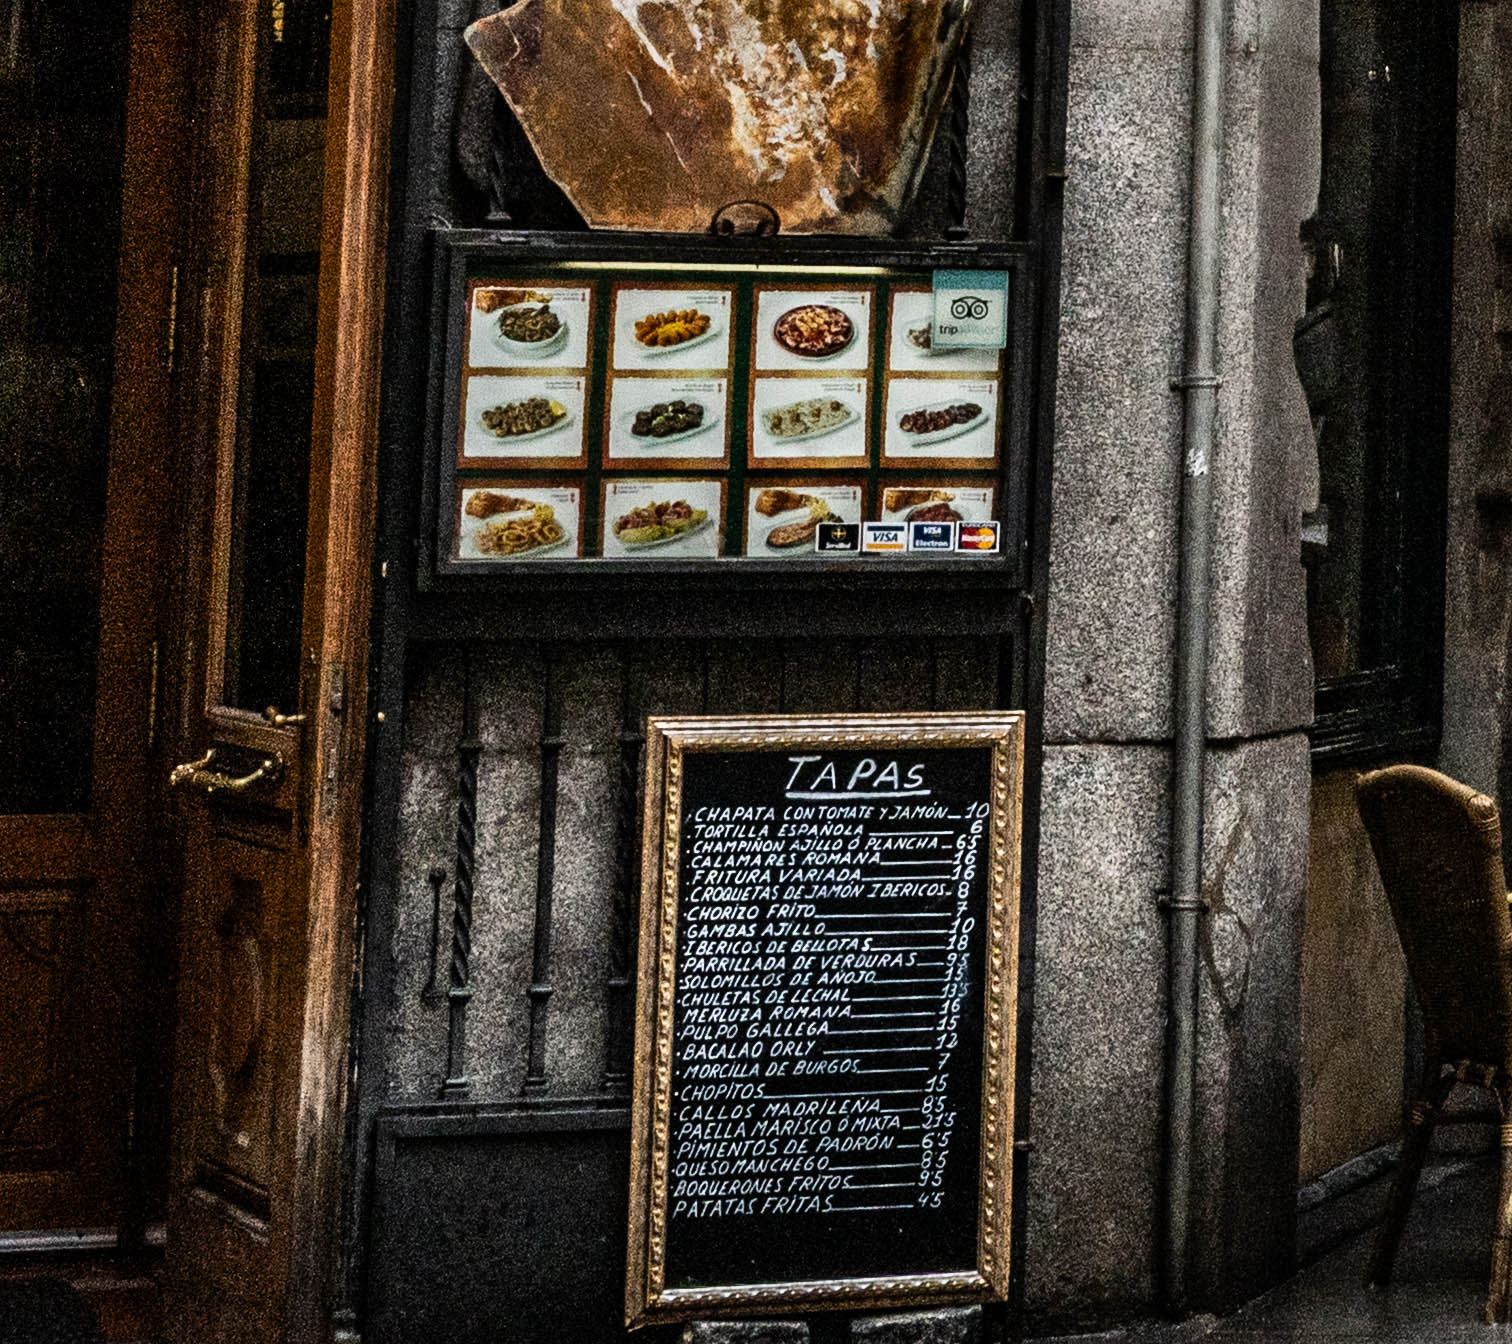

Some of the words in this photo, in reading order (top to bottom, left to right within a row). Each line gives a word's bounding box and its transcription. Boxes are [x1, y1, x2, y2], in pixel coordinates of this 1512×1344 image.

[872, 531, 899, 543] VISA
[786, 755, 925, 791] TAPAS
[695, 806, 776, 823] CHAPATA
[783, 805, 816, 821] CON
[818, 805, 875, 820] TOMATE
[888, 801, 949, 820] JAMÓN
[965, 800, 991, 820] 10
[694, 824, 769, 840] TORTILLA
[777, 820, 864, 837] ESPAÑOLA
[970, 819, 983, 835] 6
[693, 837, 786, 854] CHAMPIÑON
[864, 836, 939, 851] PLANCHA
[691, 853, 798, 868] CALAMARES
[801, 851, 881, 866] ROMANA
[952, 849, 978, 866] 16
[692, 869, 772, 886] FRITURA
[779, 867, 862, 883] VARIADA
[951, 864, 977, 881] 16
[690, 885, 780, 903] CROQUETAS
[783, 885, 805, 900] DE
[866, 882, 947, 898] IBERICOS
[957, 881, 970, 899] 8
[687, 903, 760, 921] CHORIZO
[766, 901, 816, 919] FRITO
[956, 900, 968, 917] 7
[687, 923, 757, 938] GAMBAS
[761, 920, 826, 937] AJILLO
[949, 917, 975, 934] 10
[684, 940, 762, 956] IBERICOS
[765, 940, 788, 954] DE
[791, 937, 873, 953] BELLOTAS
[946, 934, 969, 951] 18
[683, 957, 786, 972] PARRILLADA
[792, 955, 817, 970] DE
[821, 952, 918, 969] VERDURAS
[680, 973, 785, 990] SOLOMILLOS
[789, 972, 813, 986] DE
[681, 990, 761, 1007] CHULETAS
[764, 989, 788, 1004] DE
[790, 988, 851, 1003] LECHAL
[682, 1008, 762, 1024] MERLUZA
[769, 1005, 852, 1020] ROMANA
[939, 998, 961, 1014] 16
[680, 1024, 738, 1041] PULPO
[746, 1021, 830, 1038] GALLEGA
[936, 1014, 960, 1030] 15
[682, 1041, 763, 1061] BACALAO
[770, 1040, 816, 1057] ORLY
[935, 1032, 959, 1050] 12
[683, 1061, 760, 1079] MORCILLA
[765, 1061, 789, 1077] DE
[792, 1058, 860, 1076] BURGOS
[938, 1053, 951, 1070] 7
[680, 1082, 765, 1101] CHOPITOS
[924, 1073, 949, 1092] 15
[680, 1103, 756, 1121] CALLOS
[762, 1096, 880, 1117] MADRILEÑA
[678, 1122, 746, 1140] PAELLA
[750, 1117, 831, 1137] MARISCO
[850, 1115, 900, 1133] MIXTA
[677, 1139, 779, 1159] PIMIENTOS
[783, 1138, 809, 1154] DE
[815, 1132, 894, 1154] PADRÓN
[675, 1160, 730, 1176] QUESO
[730, 1156, 830, 1174] MANCHEGO
[673, 1177, 784, 1197] BOQUERONES
[788, 1173, 854, 1192] FRITOS
[672, 1197, 758, 1219] PATATAS
[760, 1193, 834, 1214] FRITAS
